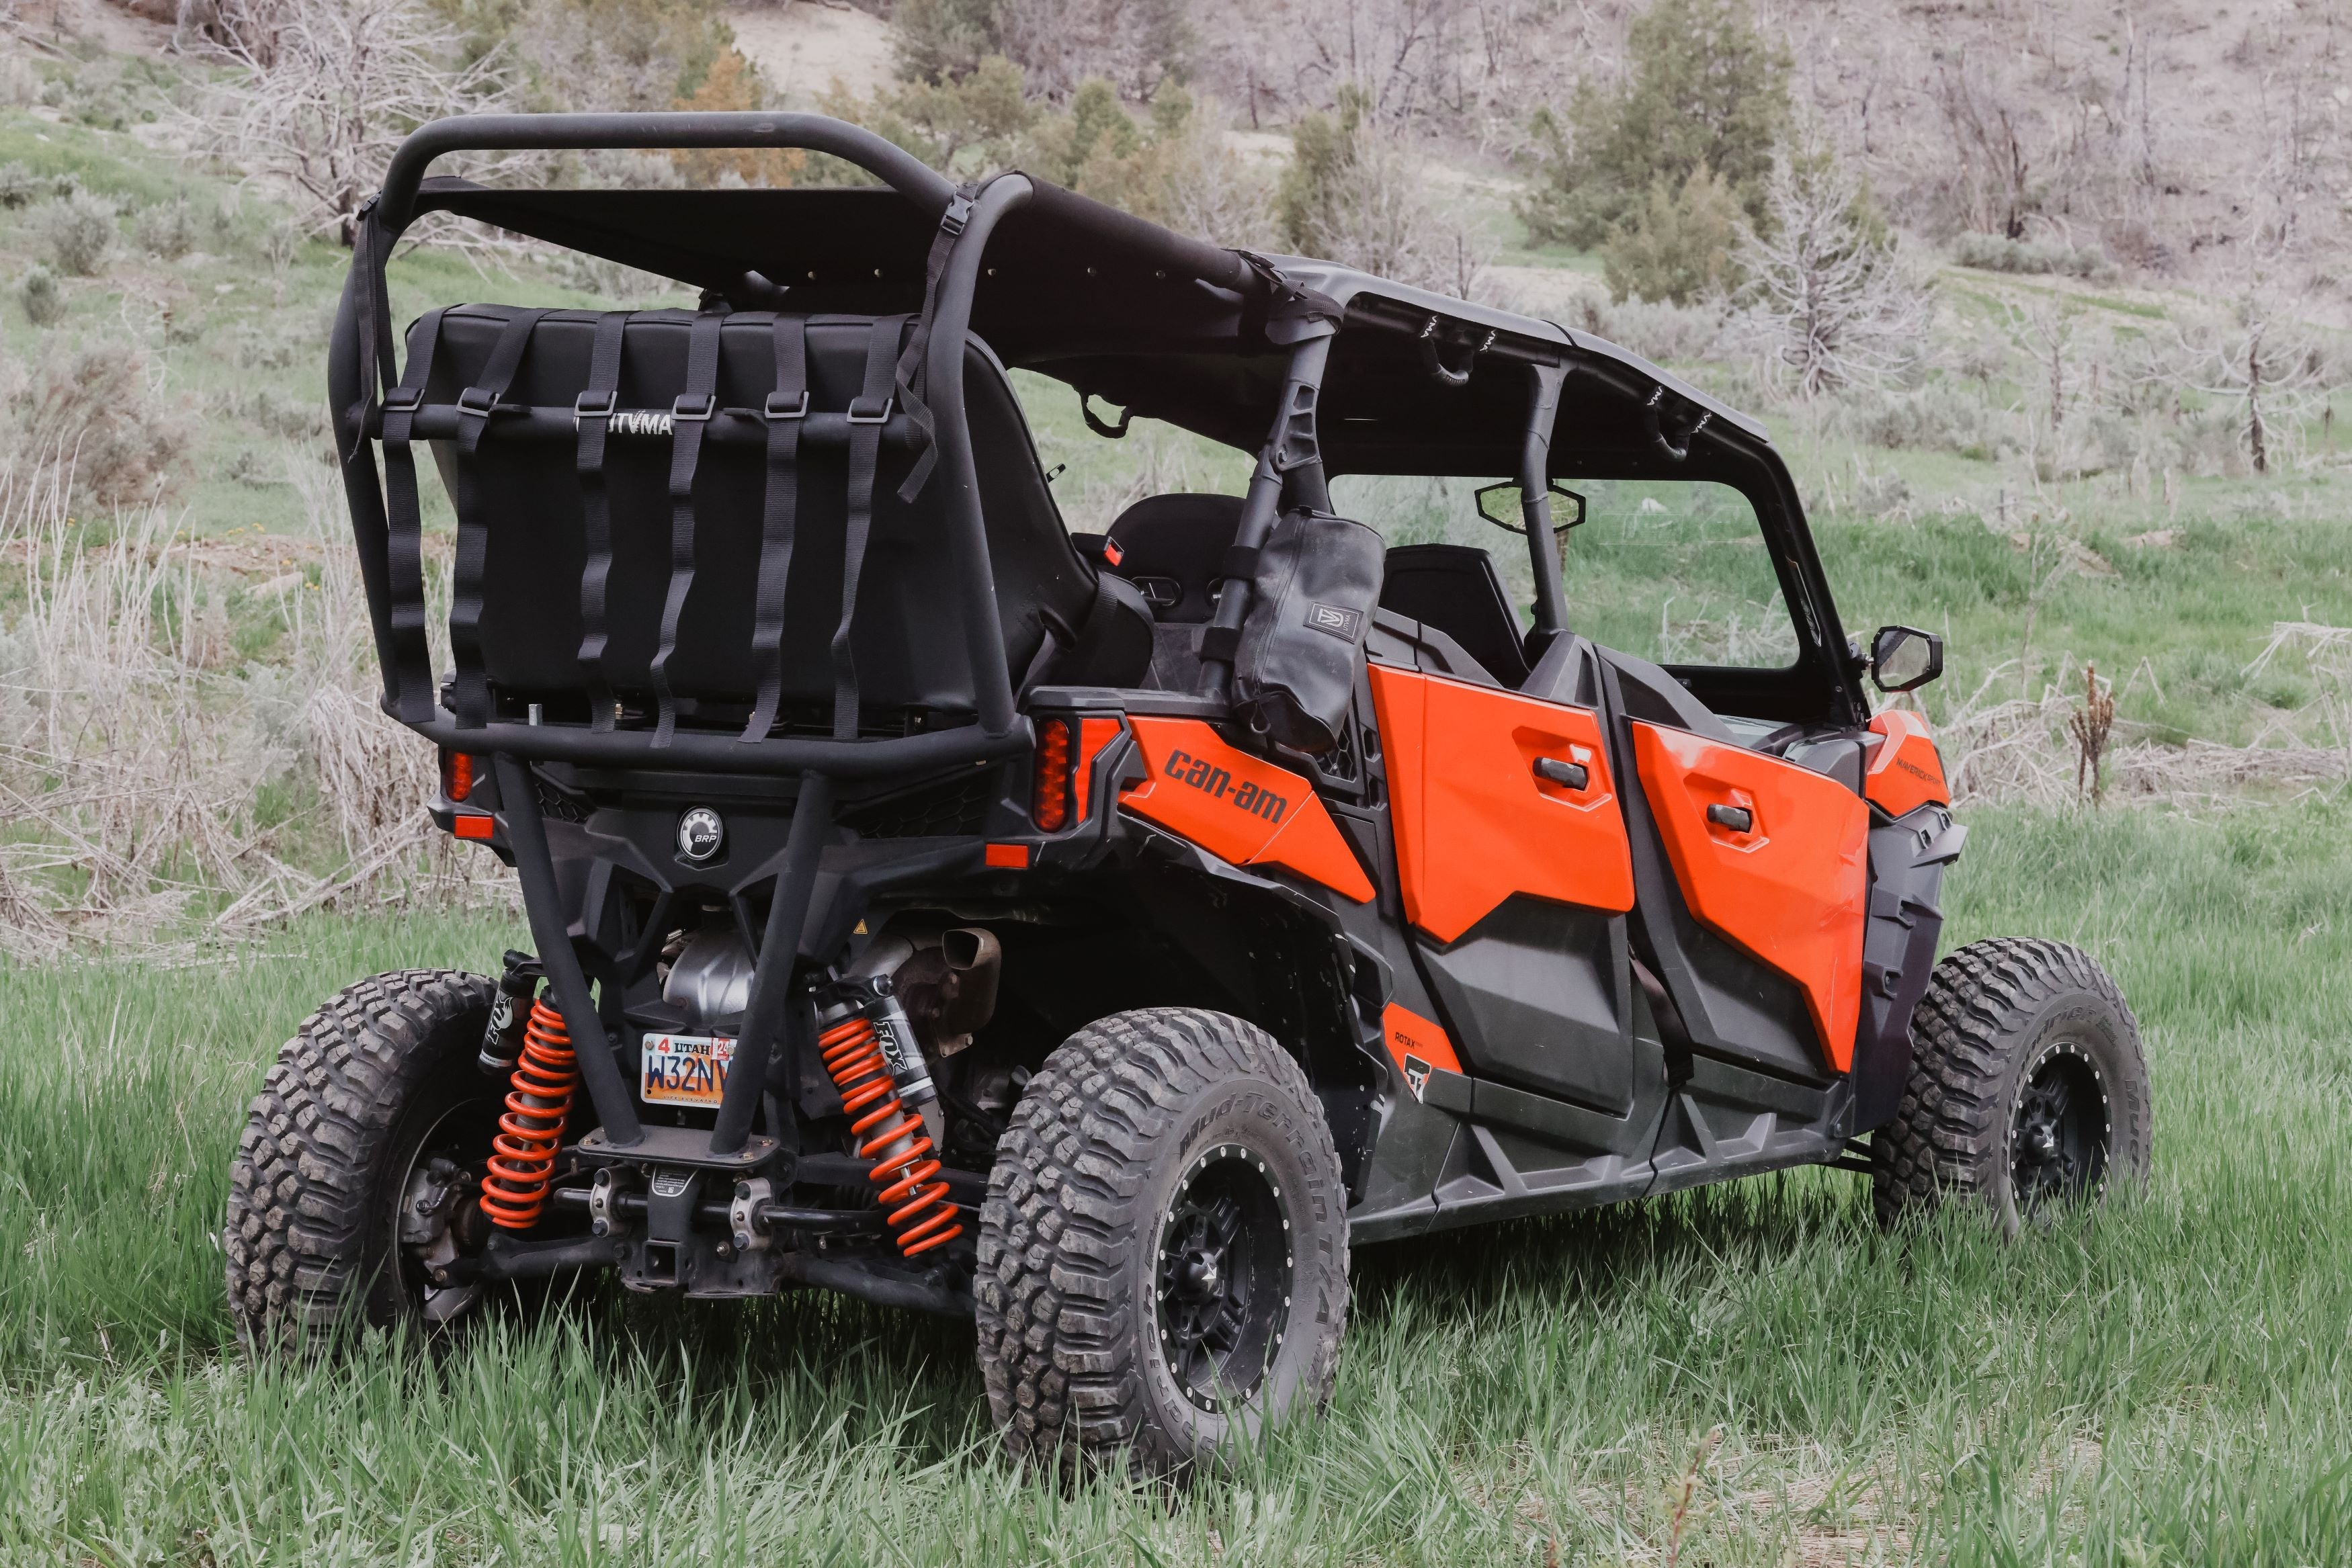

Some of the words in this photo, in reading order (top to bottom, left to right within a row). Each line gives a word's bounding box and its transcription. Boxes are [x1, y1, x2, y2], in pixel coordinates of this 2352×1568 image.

[1343, 615, 1351, 631] UTVMA
[1896, 757, 1928, 782] MAVERICK
[1165, 749, 1288, 824] can-am
[694, 834, 717, 843] BRP
[487, 990, 509, 1045] FOX
[658, 1037, 671, 1054] 4
[717, 1041, 729, 1054] 24
[874, 1022, 908, 1072] FOX
[1394, 1031, 1416, 1049] ROTAX
[674, 1043, 710, 1056] UTAH
[1179, 1092, 1328, 1223] Mud-Terrain
[1314, 1234, 1333, 1325] T/A
